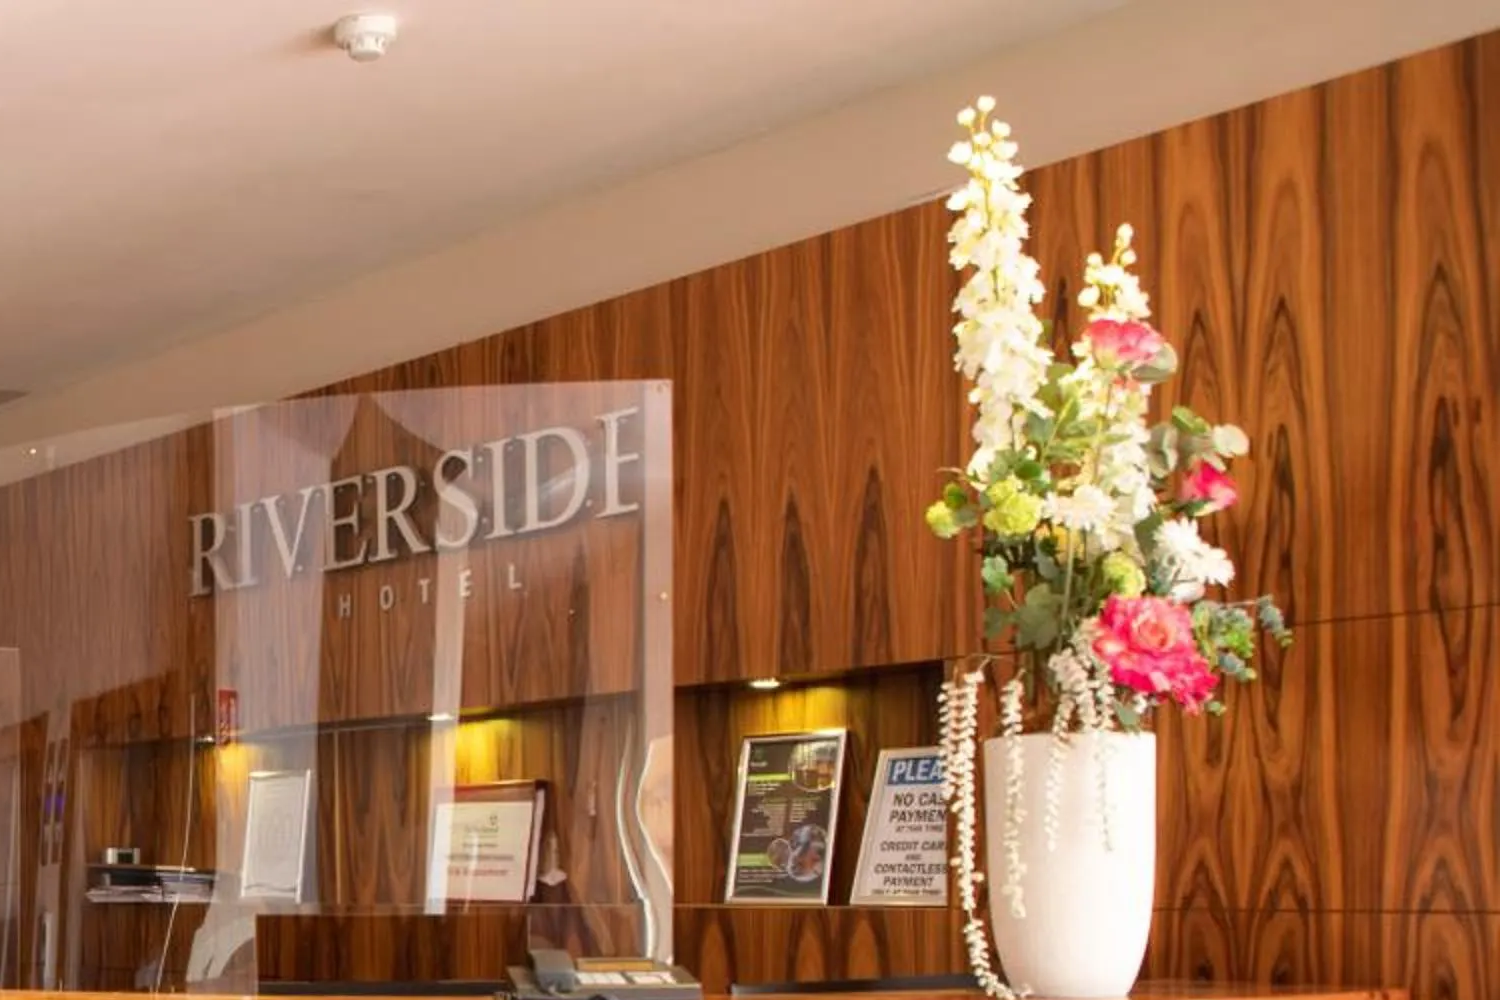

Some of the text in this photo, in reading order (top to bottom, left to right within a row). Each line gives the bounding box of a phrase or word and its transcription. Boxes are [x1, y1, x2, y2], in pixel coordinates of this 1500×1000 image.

[188, 406, 640, 597] RIVERSIDE
[338, 564, 523, 618] HOTEL
[892, 759, 944, 782] PLEA
[893, 792, 914, 806] NO
[889, 809, 946, 822] PAYMEN
[921, 841, 946, 851] CAR
[883, 876, 934, 887] PAYMENT
